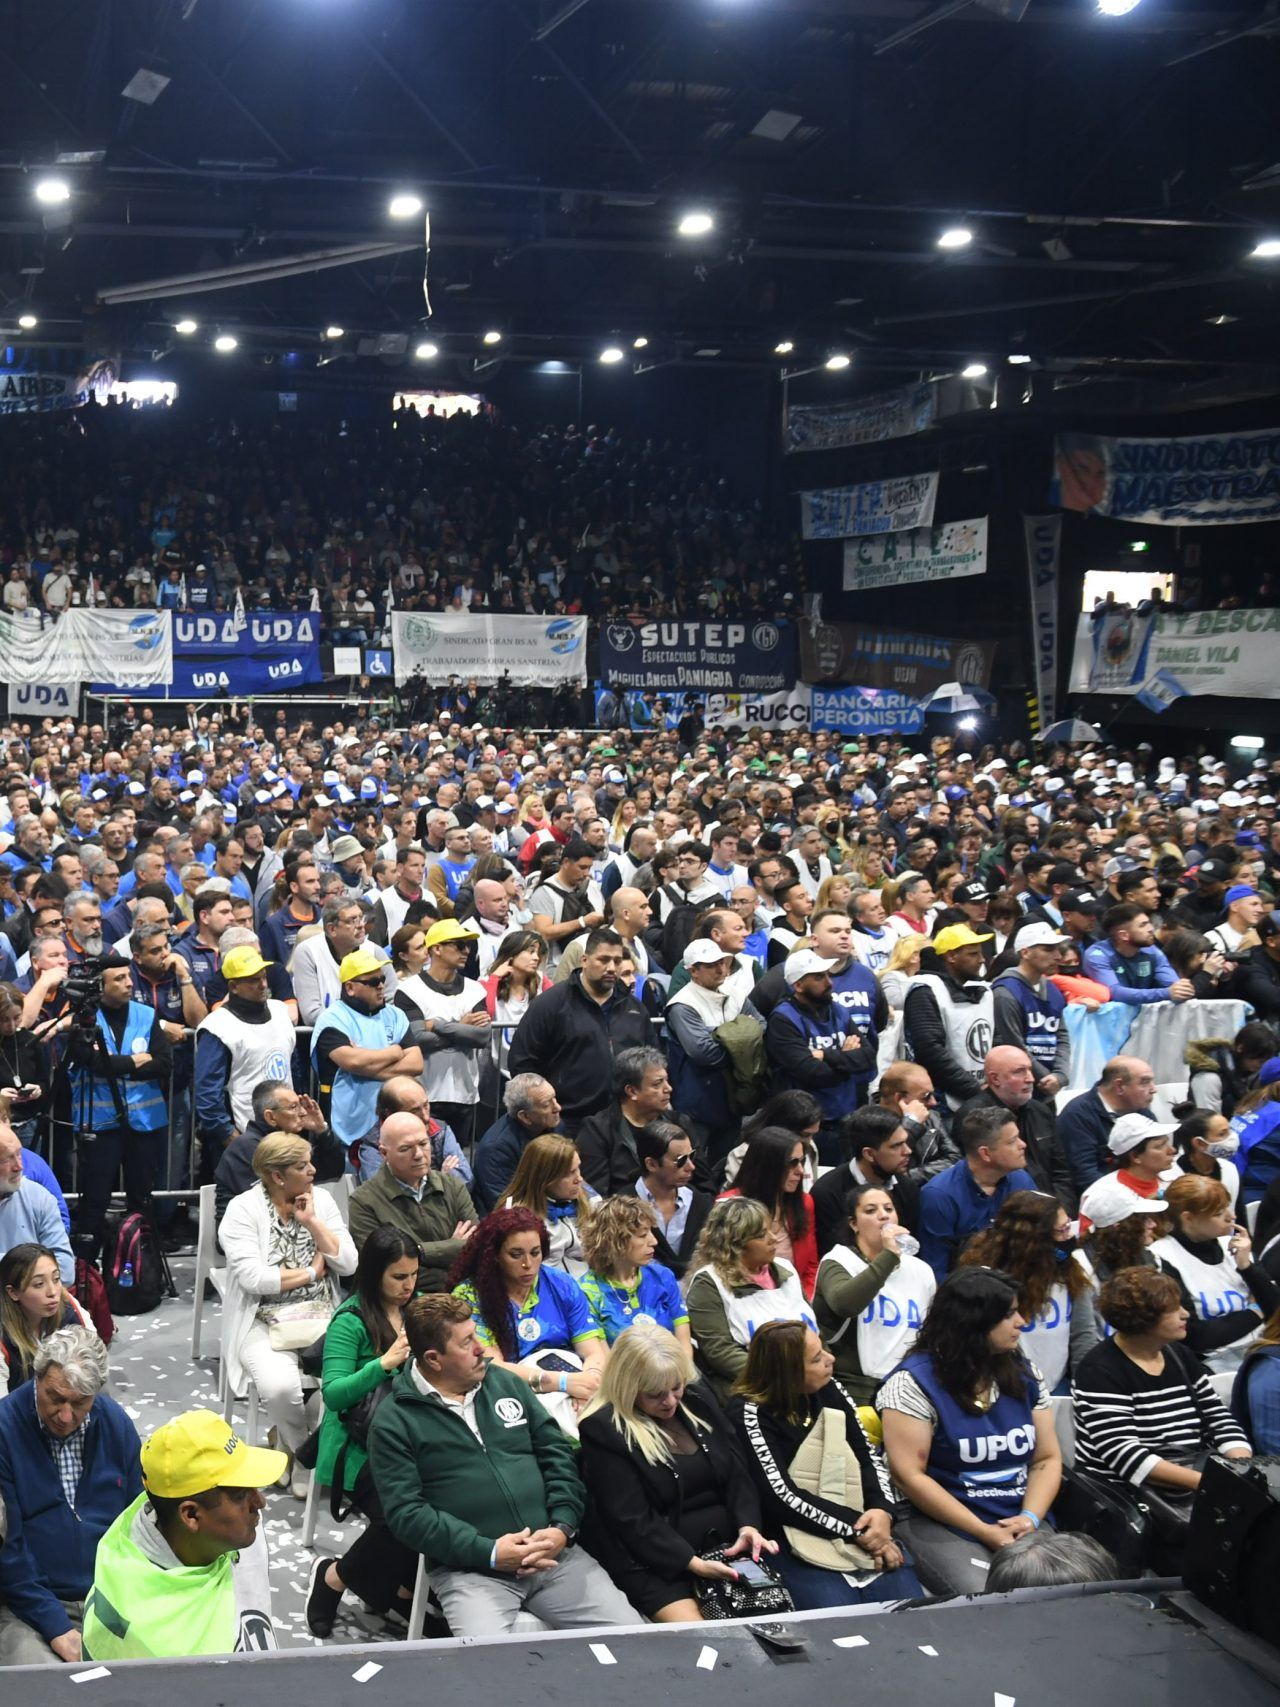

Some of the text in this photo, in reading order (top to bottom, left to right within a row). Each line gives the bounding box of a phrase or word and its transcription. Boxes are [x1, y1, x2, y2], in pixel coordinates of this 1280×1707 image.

[4, 376, 66, 397] AIRES
[641, 623, 745, 648] SUTEP
[1207, 646, 1240, 663] VILA
[17, 684, 69, 707] UDA
[745, 704, 811, 722] RUCCI
[814, 709, 920, 726] PERONISTA
[831, 990, 869, 1008] PCN
